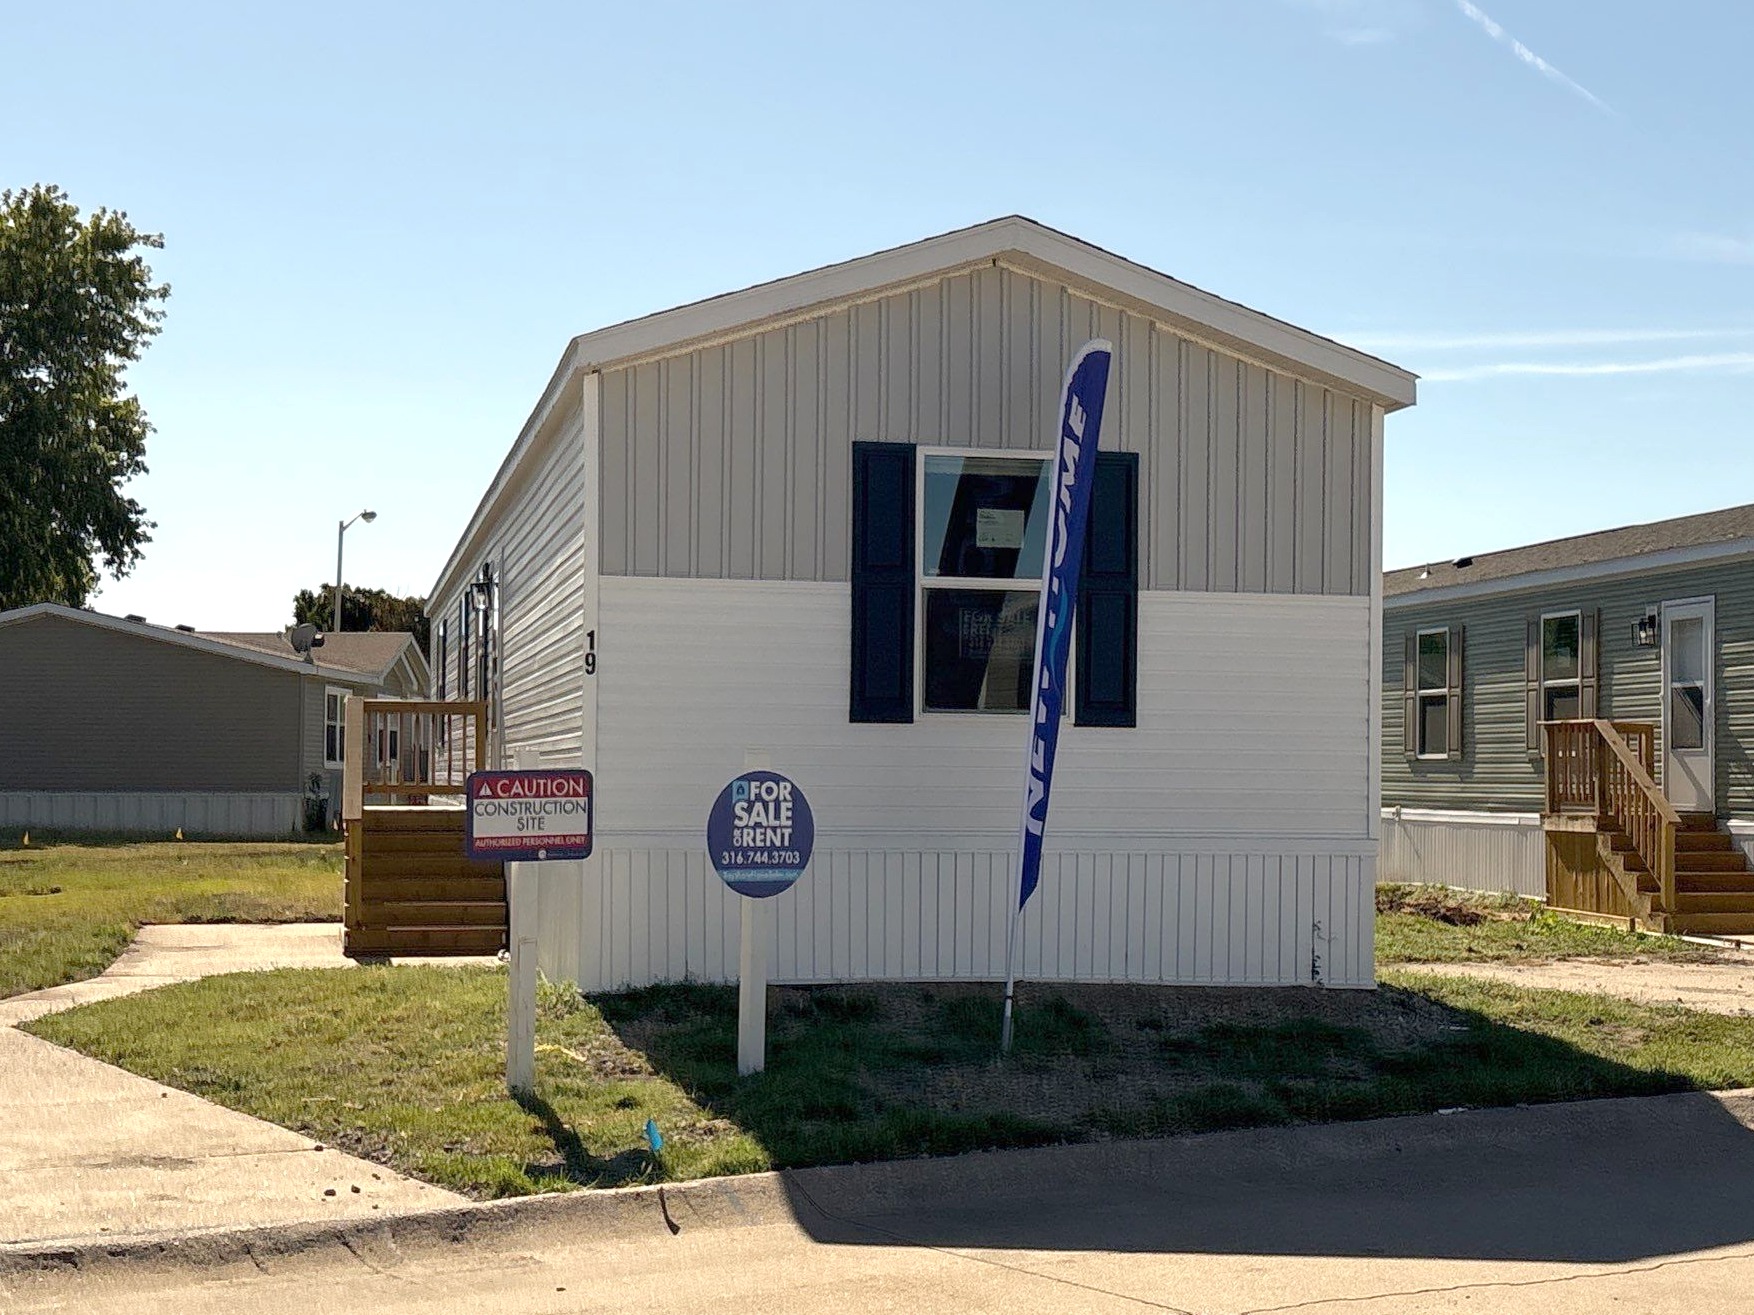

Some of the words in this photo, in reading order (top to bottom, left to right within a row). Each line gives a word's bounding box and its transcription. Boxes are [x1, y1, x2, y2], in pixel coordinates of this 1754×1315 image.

[585, 630, 596, 675] 19
[497, 778, 583, 797] CAUTION
[750, 781, 792, 801] FOR
[475, 801, 586, 816] CONSTRUCTION
[734, 801, 793, 827] SALE
[517, 817, 545, 831] SITE
[733, 828, 742, 847] OR
[742, 828, 793, 847] RENT
[722, 851, 800, 865] 316.744.3703
